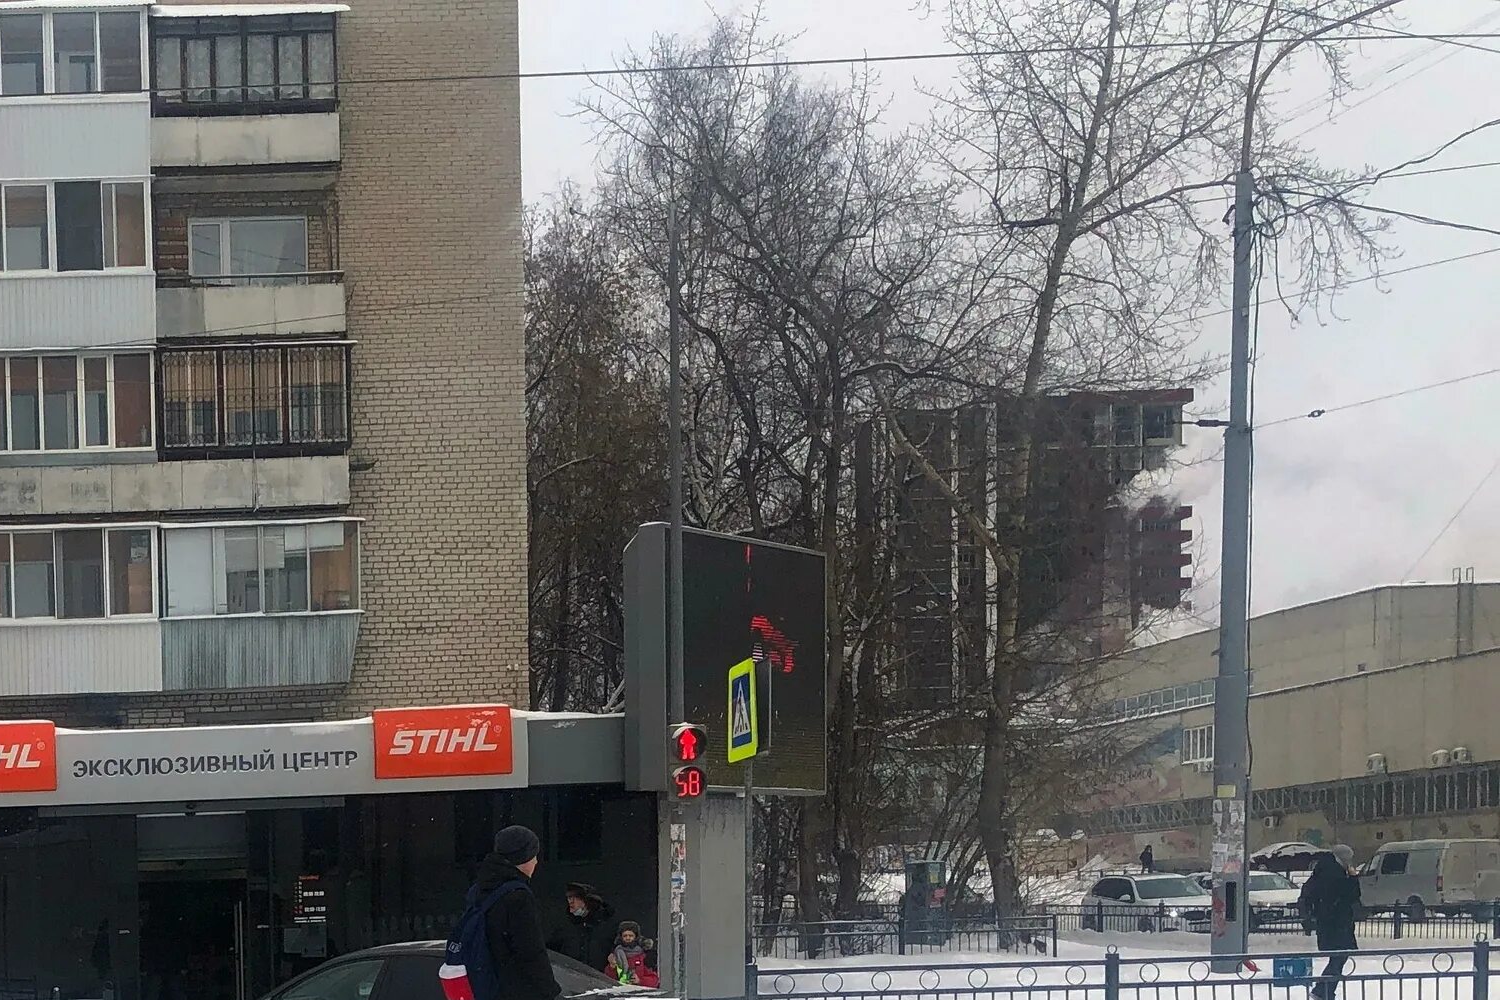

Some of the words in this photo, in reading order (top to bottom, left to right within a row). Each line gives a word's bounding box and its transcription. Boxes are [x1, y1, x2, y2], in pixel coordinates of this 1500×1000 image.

[388, 725, 498, 755] STIHL
[72, 749, 275, 778] ЭКСКЛЮЗИВНЫЙ
[282, 750, 358, 773] ЦЕНТР
[675, 770, 700, 797] 58
